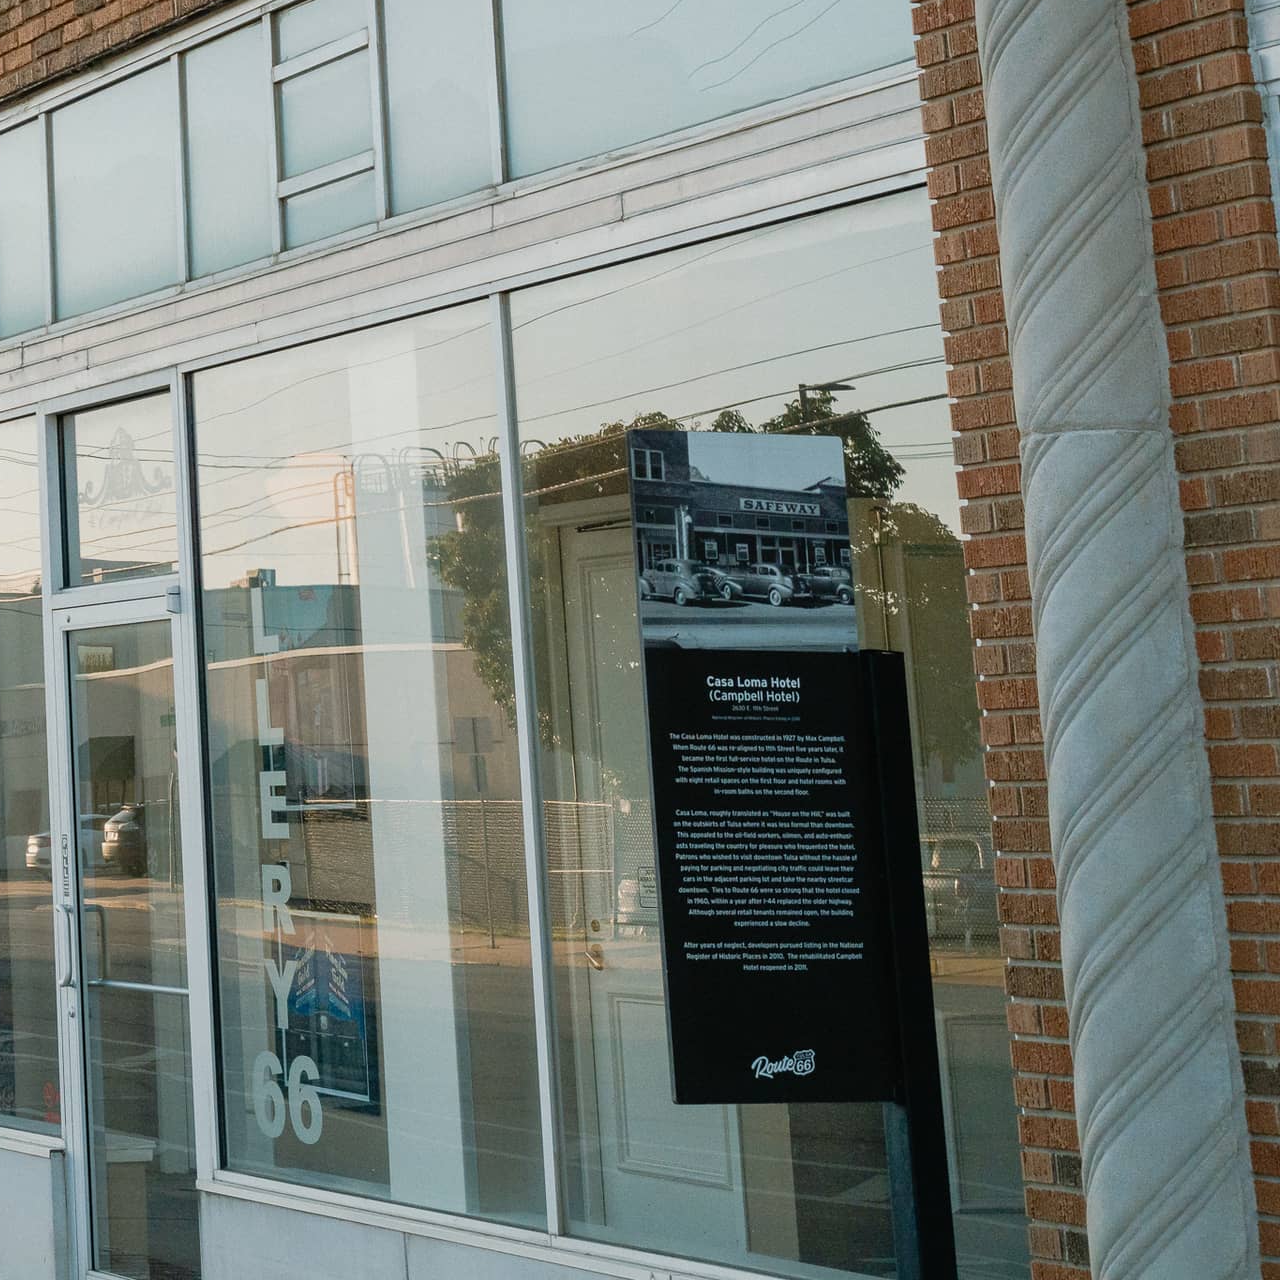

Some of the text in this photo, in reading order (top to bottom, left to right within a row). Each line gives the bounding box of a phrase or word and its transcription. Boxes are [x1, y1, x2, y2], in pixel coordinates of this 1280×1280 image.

[743, 498, 818, 515] SAFEWAY
[707, 675, 800, 689] Casa Loma Hotel
[709, 689, 800, 703] (Campbell Hotel)
[751, 1055, 812, 1079] Route 66
[253, 1050, 323, 1145] 66
